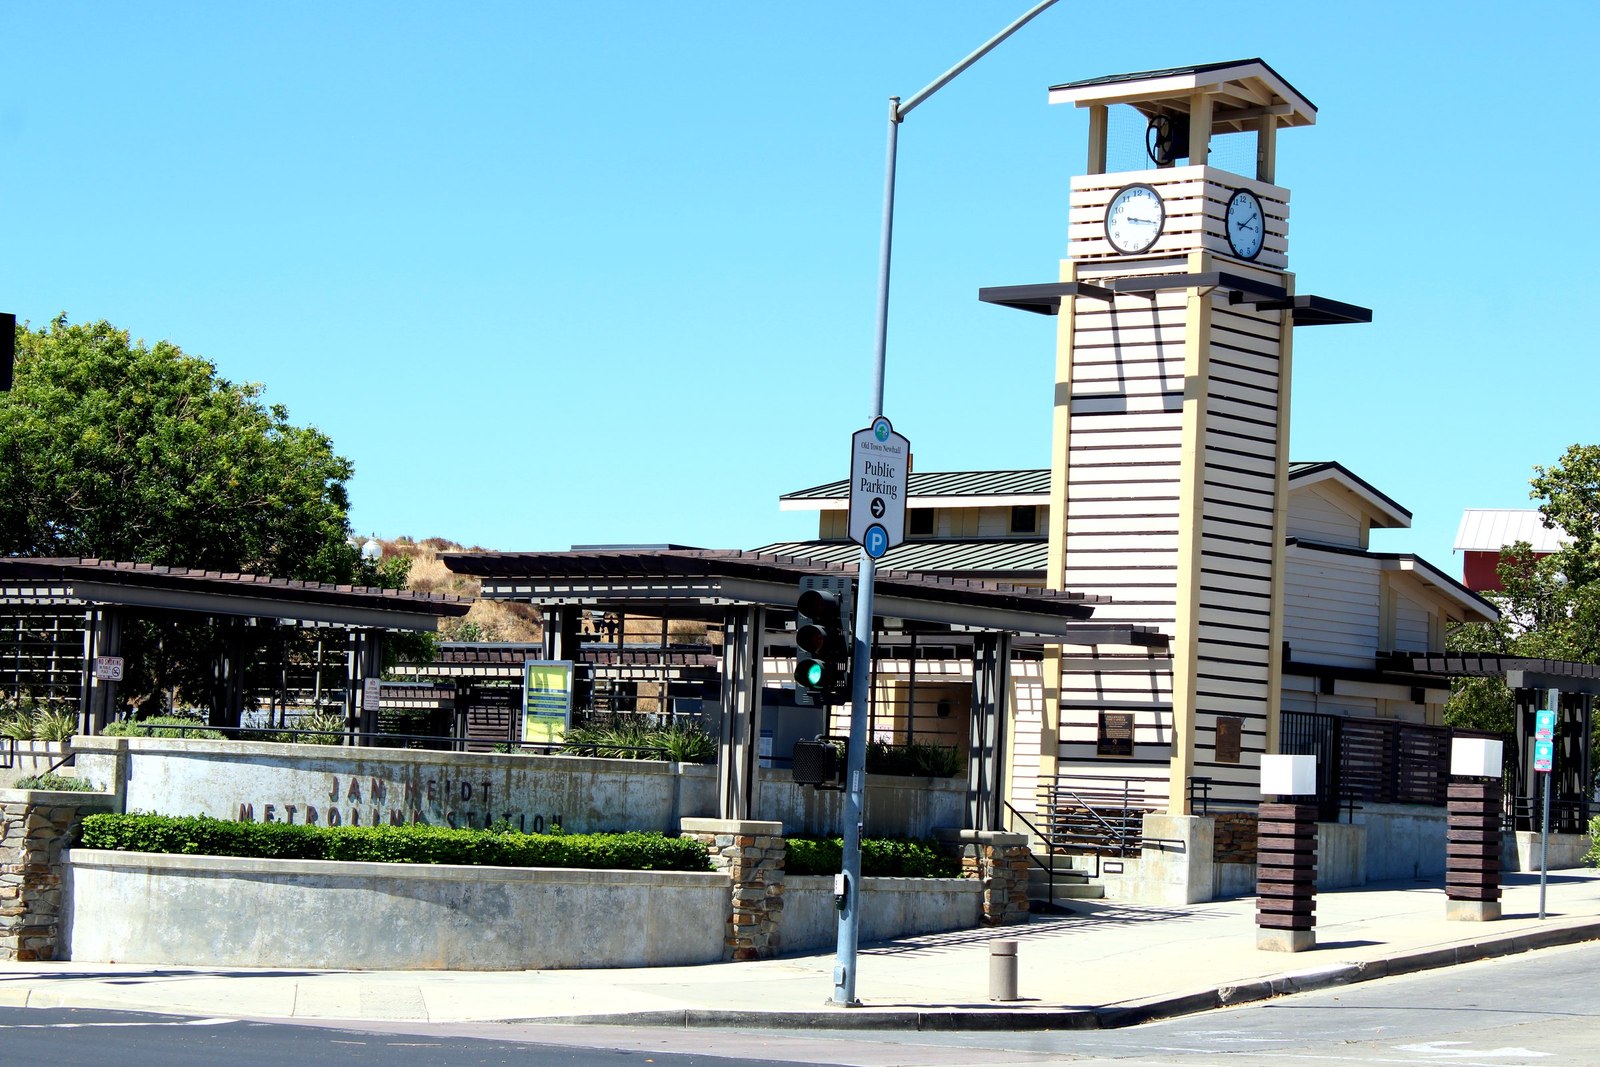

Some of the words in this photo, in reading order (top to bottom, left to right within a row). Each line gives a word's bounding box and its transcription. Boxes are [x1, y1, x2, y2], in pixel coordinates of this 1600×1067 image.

[861, 442, 870, 450] Old
[870, 443, 882, 451] Town
[883, 445, 901, 453] Newhall
[865, 461, 895, 478] Public
[860, 478, 897, 500] Parking
[872, 533, 882, 551] P
[329, 776, 386, 805] JAN
[405, 778, 492, 802] HEIDT
[239, 803, 424, 828] METROLINK
[446, 811, 563, 834] STATION
